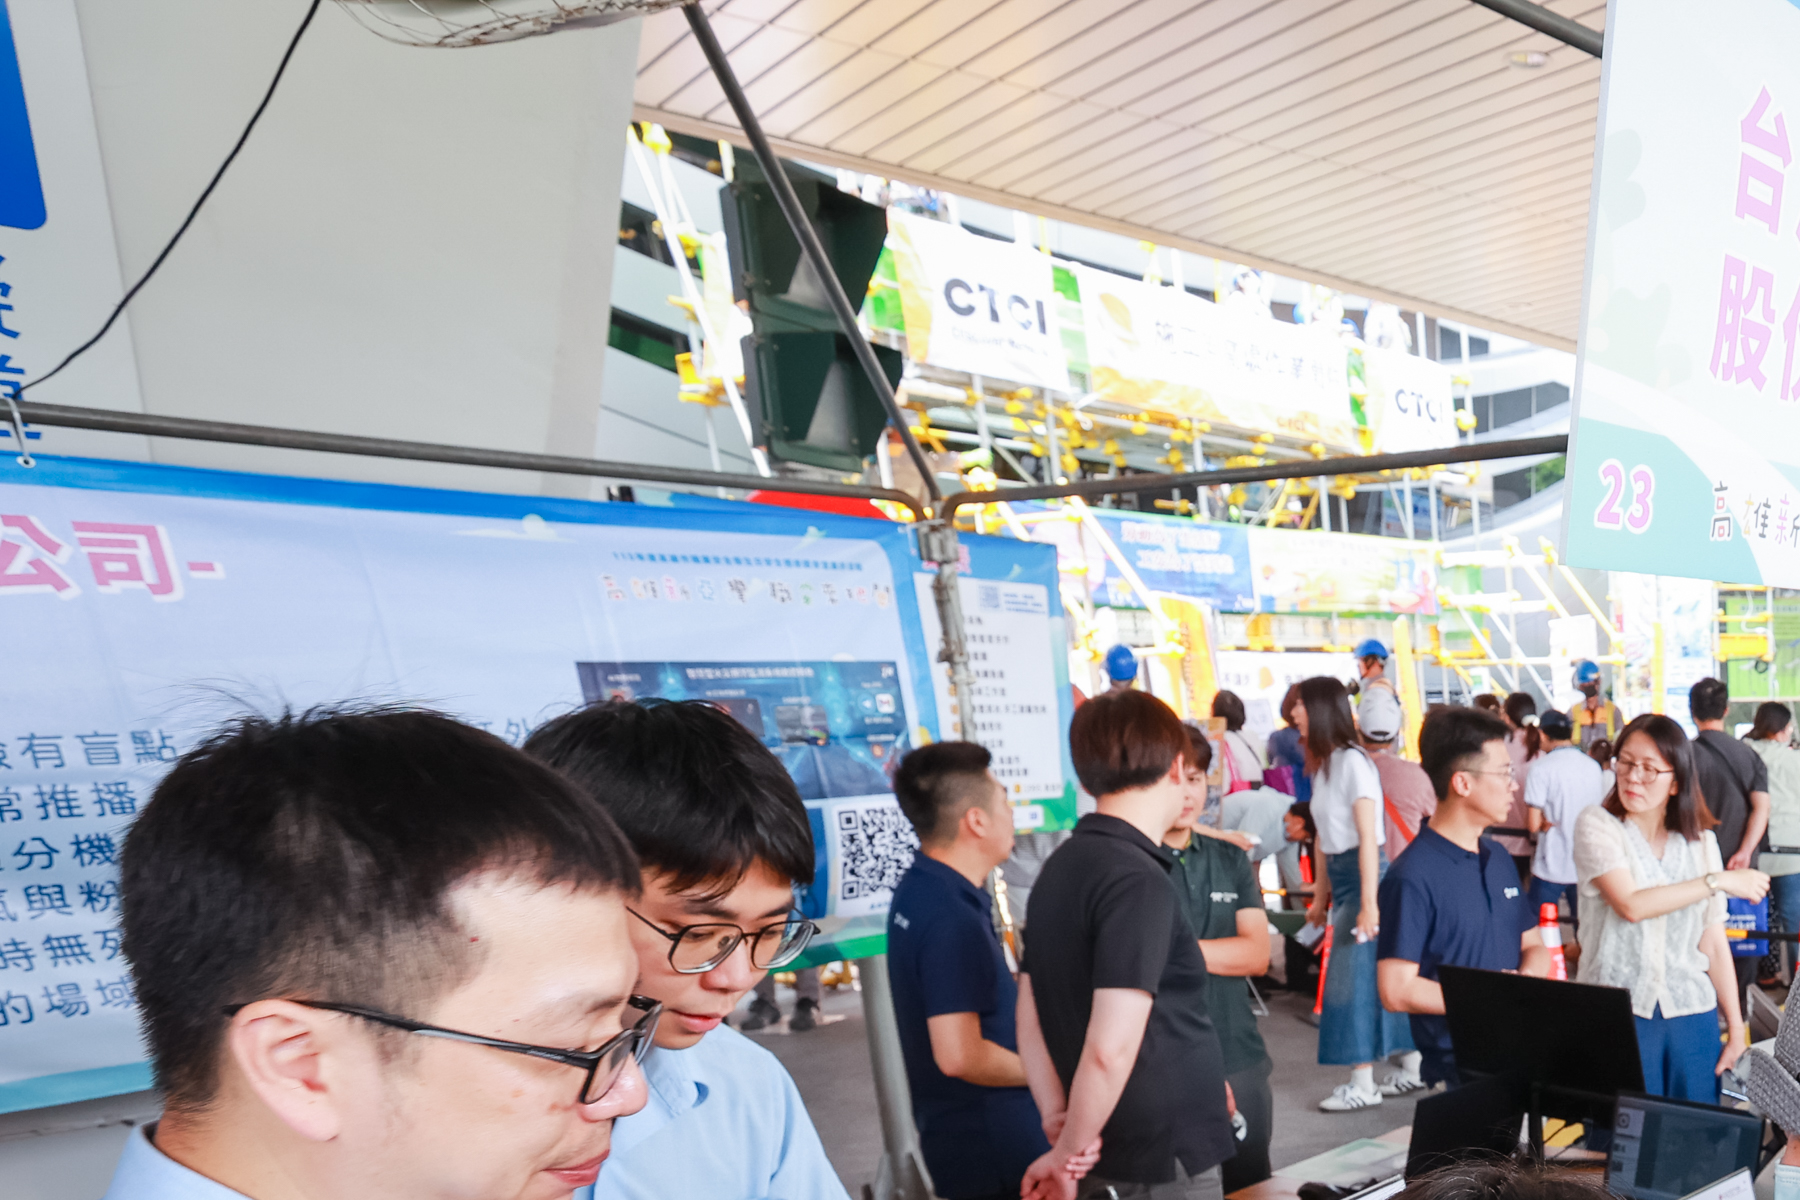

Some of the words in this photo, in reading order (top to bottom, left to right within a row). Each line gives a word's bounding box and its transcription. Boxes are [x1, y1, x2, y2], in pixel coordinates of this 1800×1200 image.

[944, 278, 1047, 334] CTCI
[1395, 389, 1443, 424] CTCI
[1597, 464, 1652, 529] 23
[0, 729, 177, 770] 有盲點
[0, 833, 117, 870] 分機
